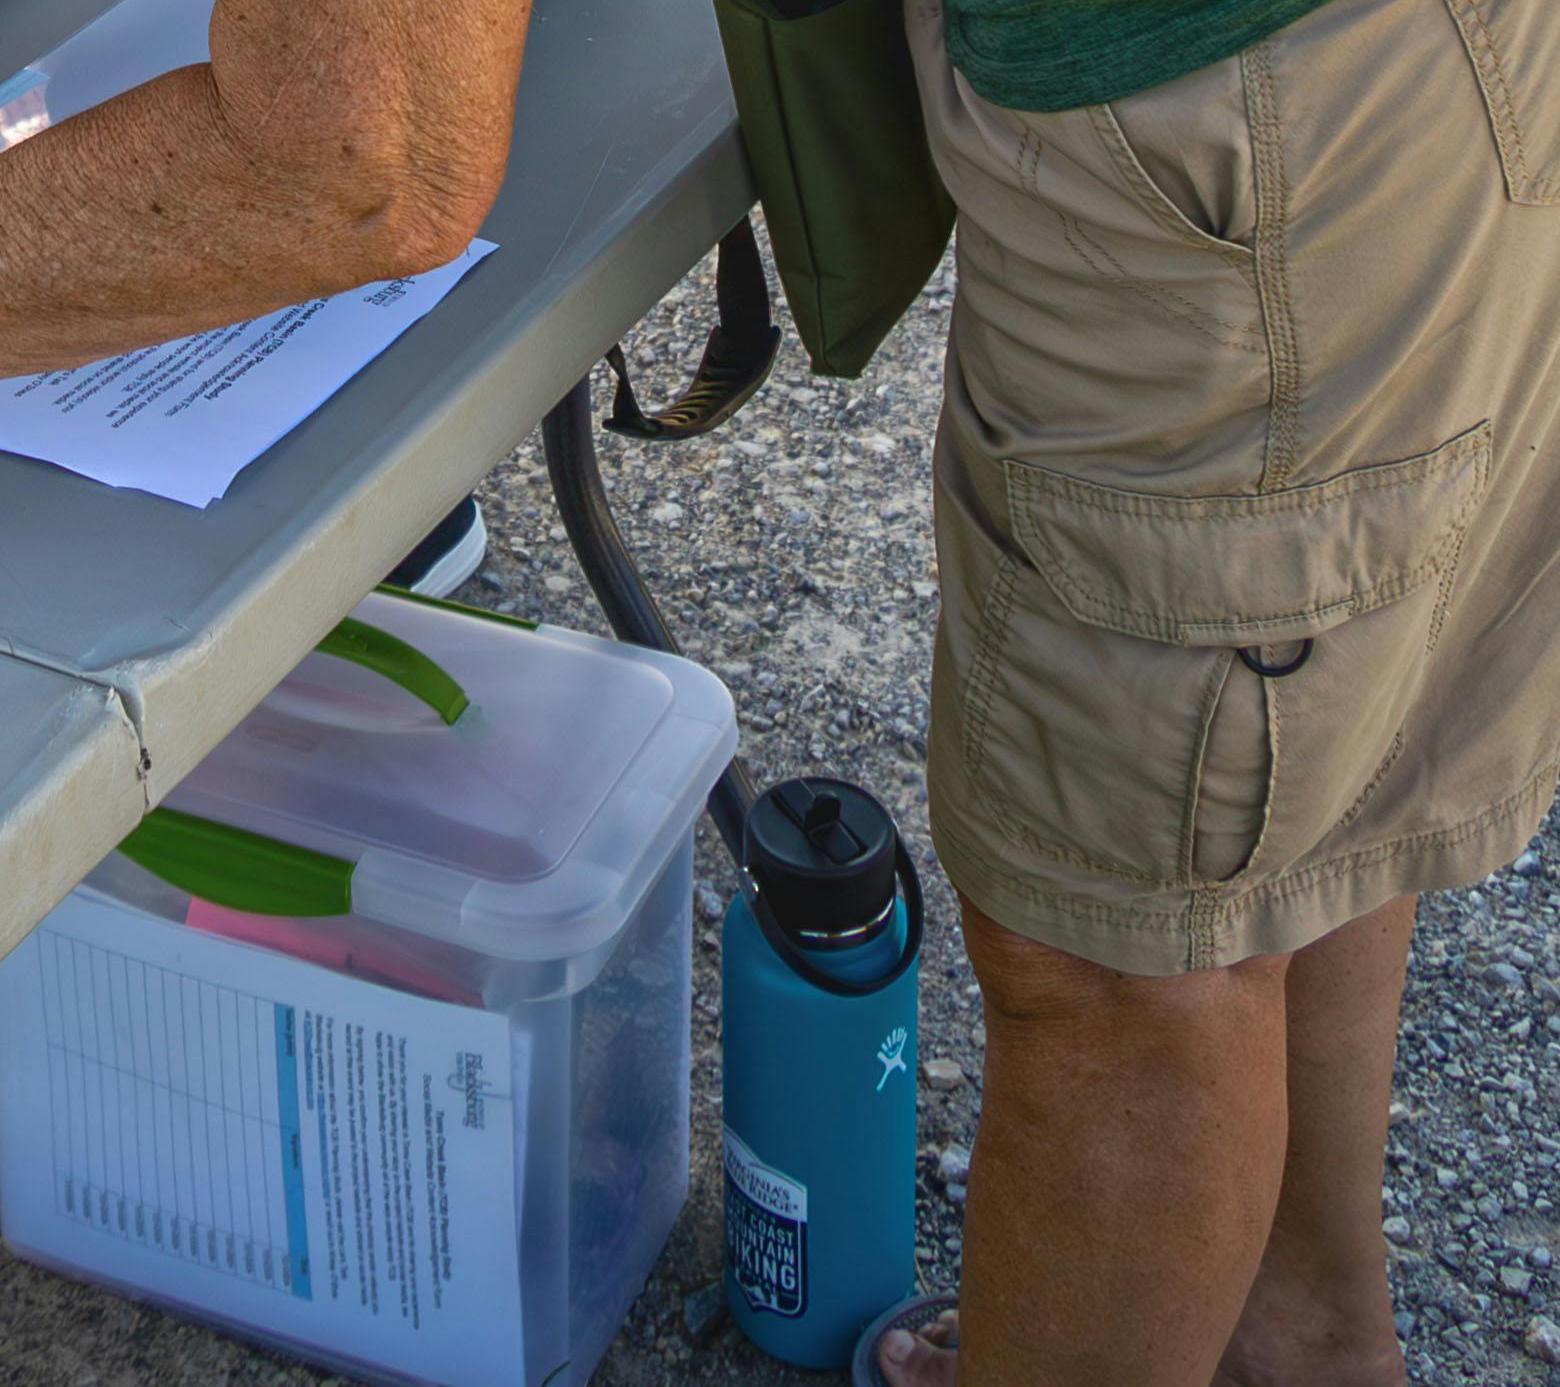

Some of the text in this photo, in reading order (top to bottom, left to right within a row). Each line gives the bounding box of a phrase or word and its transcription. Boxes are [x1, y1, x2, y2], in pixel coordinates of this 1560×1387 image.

[268, 307, 303, 331] Website
[299, 302, 327, 320] Creek
[277, 320, 306, 339] Basin
[242, 331, 275, 353] Content
[182, 352, 249, 403] Acknowledgement
[225, 355, 264, 382] Planning
[203, 381, 233, 401] Study
[750, 1213, 794, 1246] COAST
